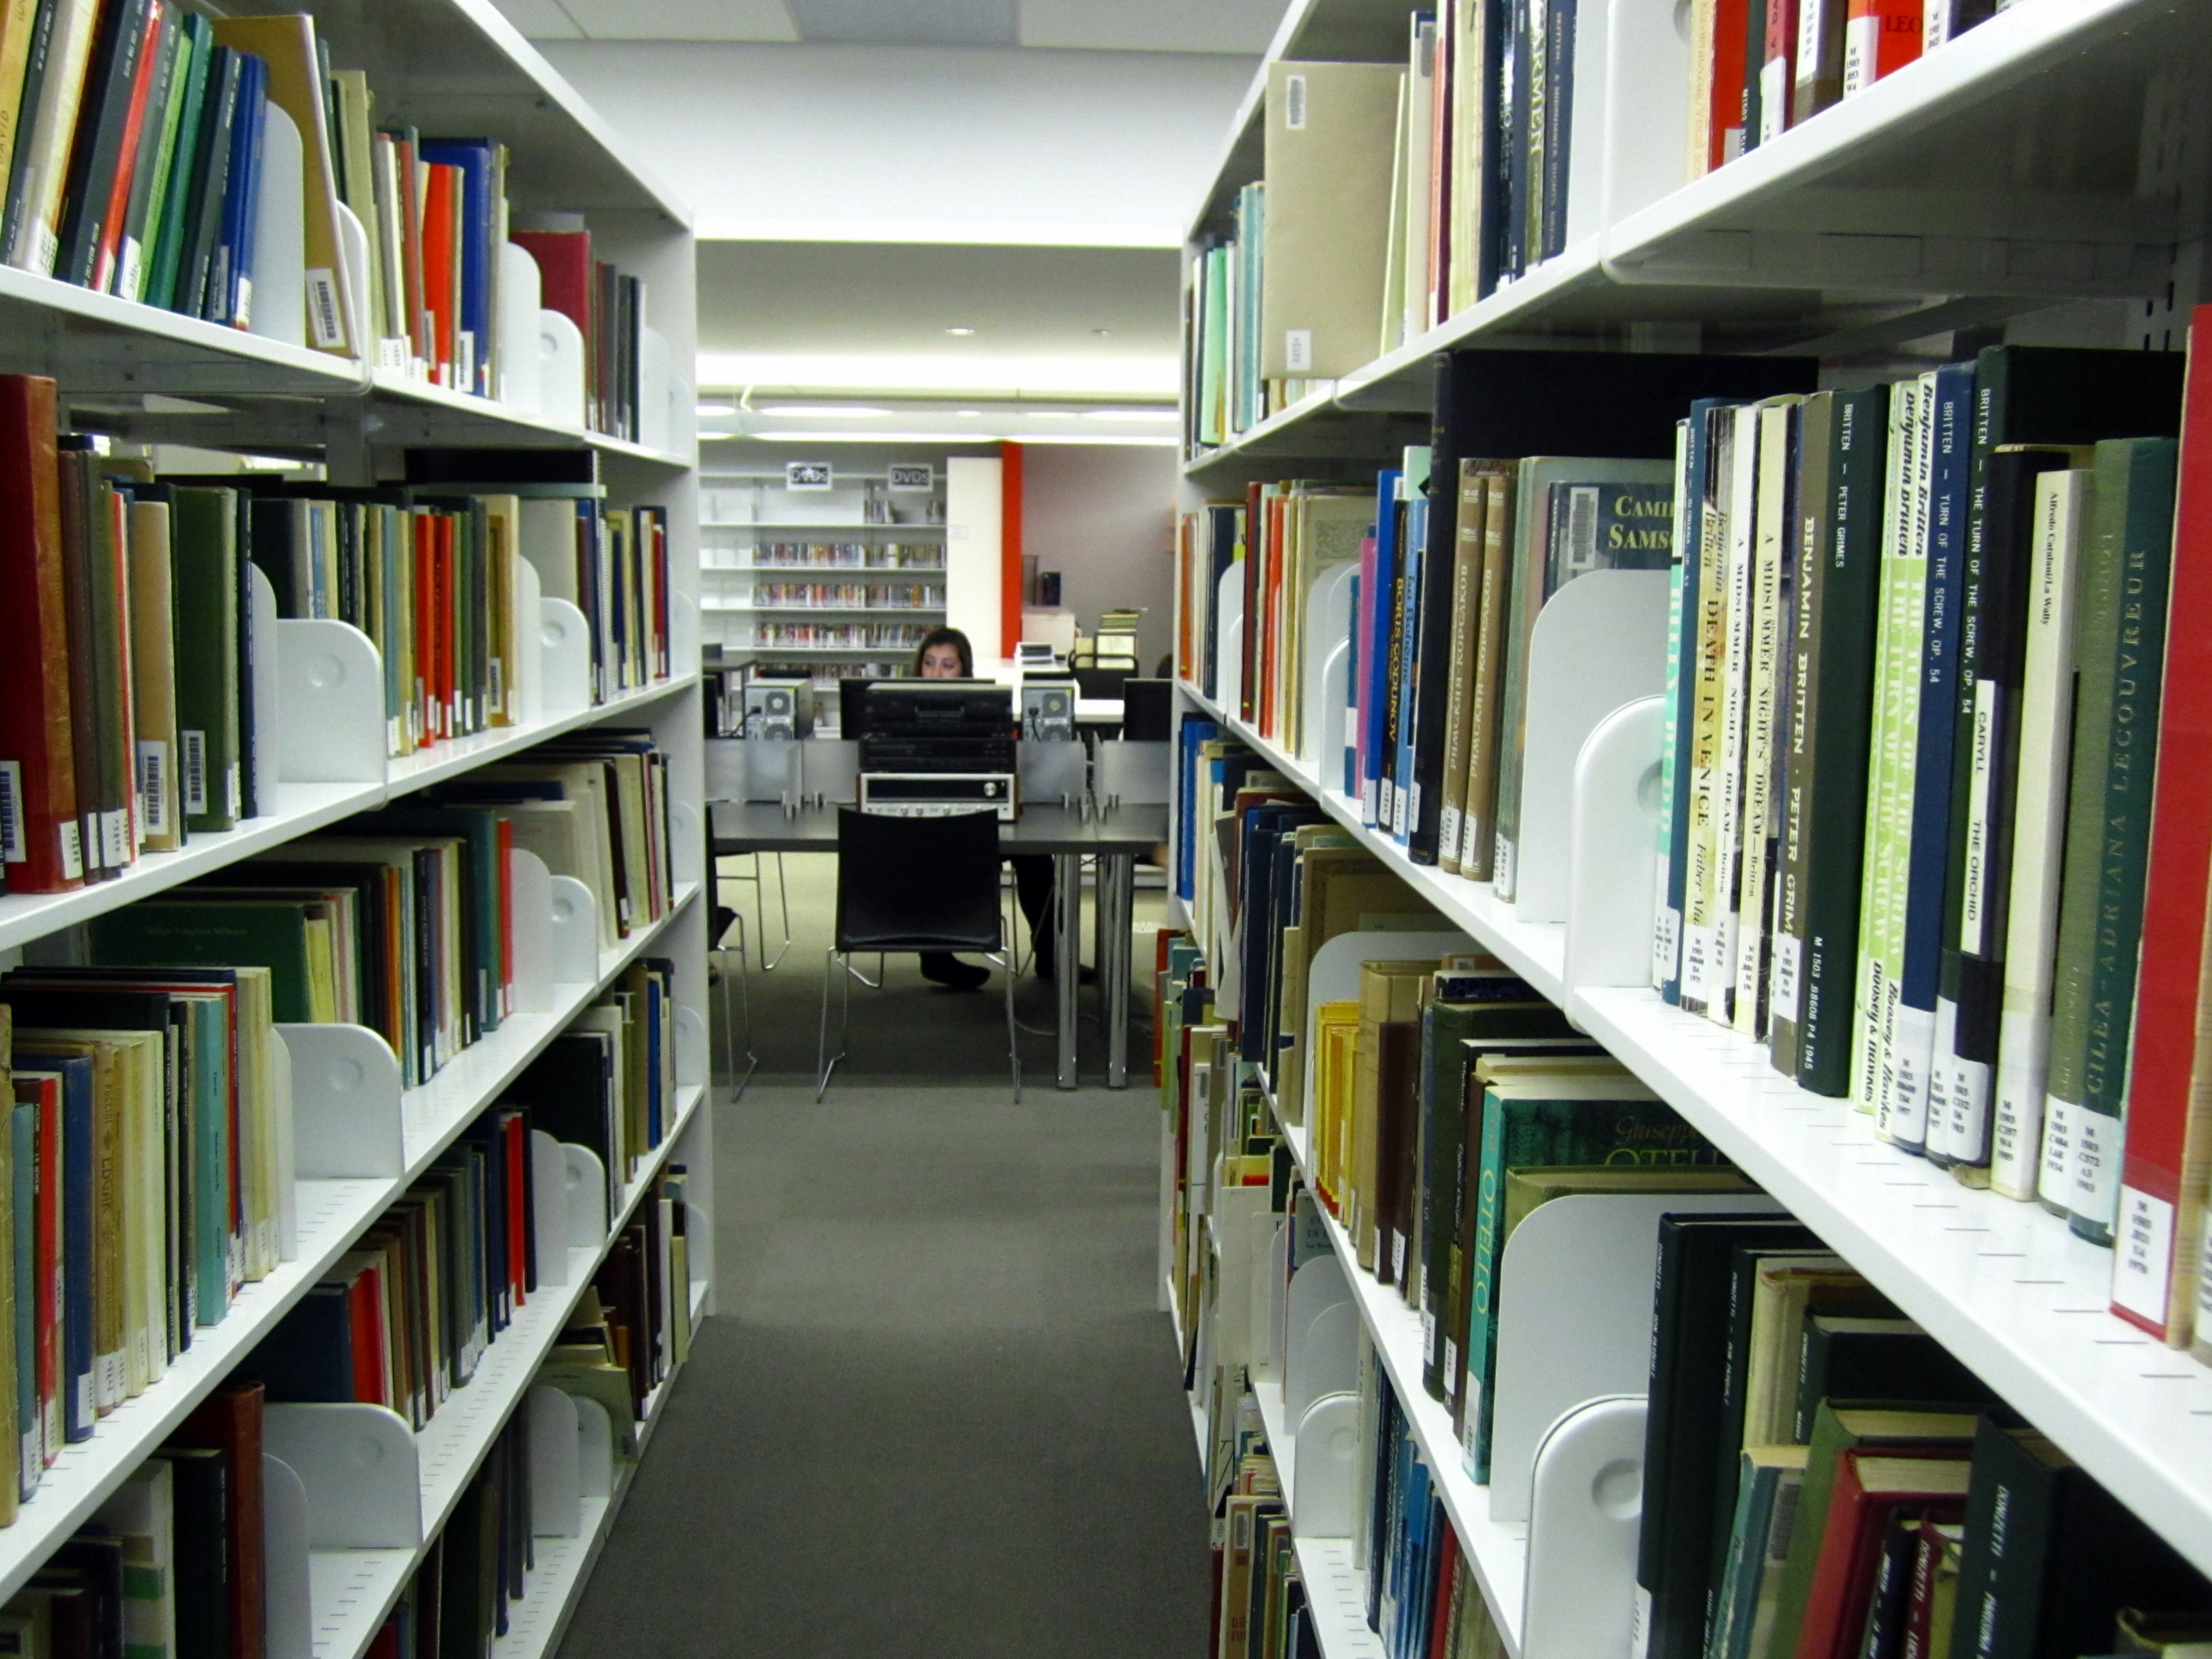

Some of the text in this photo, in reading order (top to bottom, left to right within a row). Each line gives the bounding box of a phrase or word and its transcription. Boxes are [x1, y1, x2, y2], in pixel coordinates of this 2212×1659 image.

[1942, 401, 1953, 454] BRITTEN
[1977, 389, 1991, 445] BRITTEN
[1834, 403, 1854, 569] BRITTEN PETER GRIMES
[1912, 383, 1934, 557] Benjamin Britten
[1972, 486, 1985, 511] THE
[1938, 494, 1952, 526] TURN
[1971, 520, 1982, 554] TURN
[1715, 511, 1727, 594] Benjamin
[1935, 557, 1946, 581] THE
[1937, 534, 1948, 552] OF
[1969, 562, 1980, 578] OF
[1394, 577, 1405, 639] BORIS
[1732, 563, 1744, 673] MIDSUMMER
[1760, 559, 1774, 671] MIDSUMMER
[1968, 586, 1980, 609] THE
[1703, 600, 1719, 682] DEATH
[1388, 643, 1402, 742] GODUNOV
[1788, 516, 1816, 862] BENJAMIN BRITTEN PETER
[1929, 668, 1941, 684] 54
[1961, 698, 1973, 714] 54
[1702, 696, 1715, 723] IN
[1697, 733, 1713, 827] VENICE
[1967, 711, 1987, 921] CARYLL THE ORCHID
[2087, 550, 2145, 1094] CILEA ADRIANA LECOUVREUR
[1811, 952, 1823, 978] 1503
[1813, 936, 1823, 947] M
[1882, 981, 1899, 1046] Boosey
[1879, 1063, 1895, 1131] Hawkes
[1475, 1168, 1496, 1315] OTELLO
[1990, 1484, 2010, 1557] DONIZETTI
